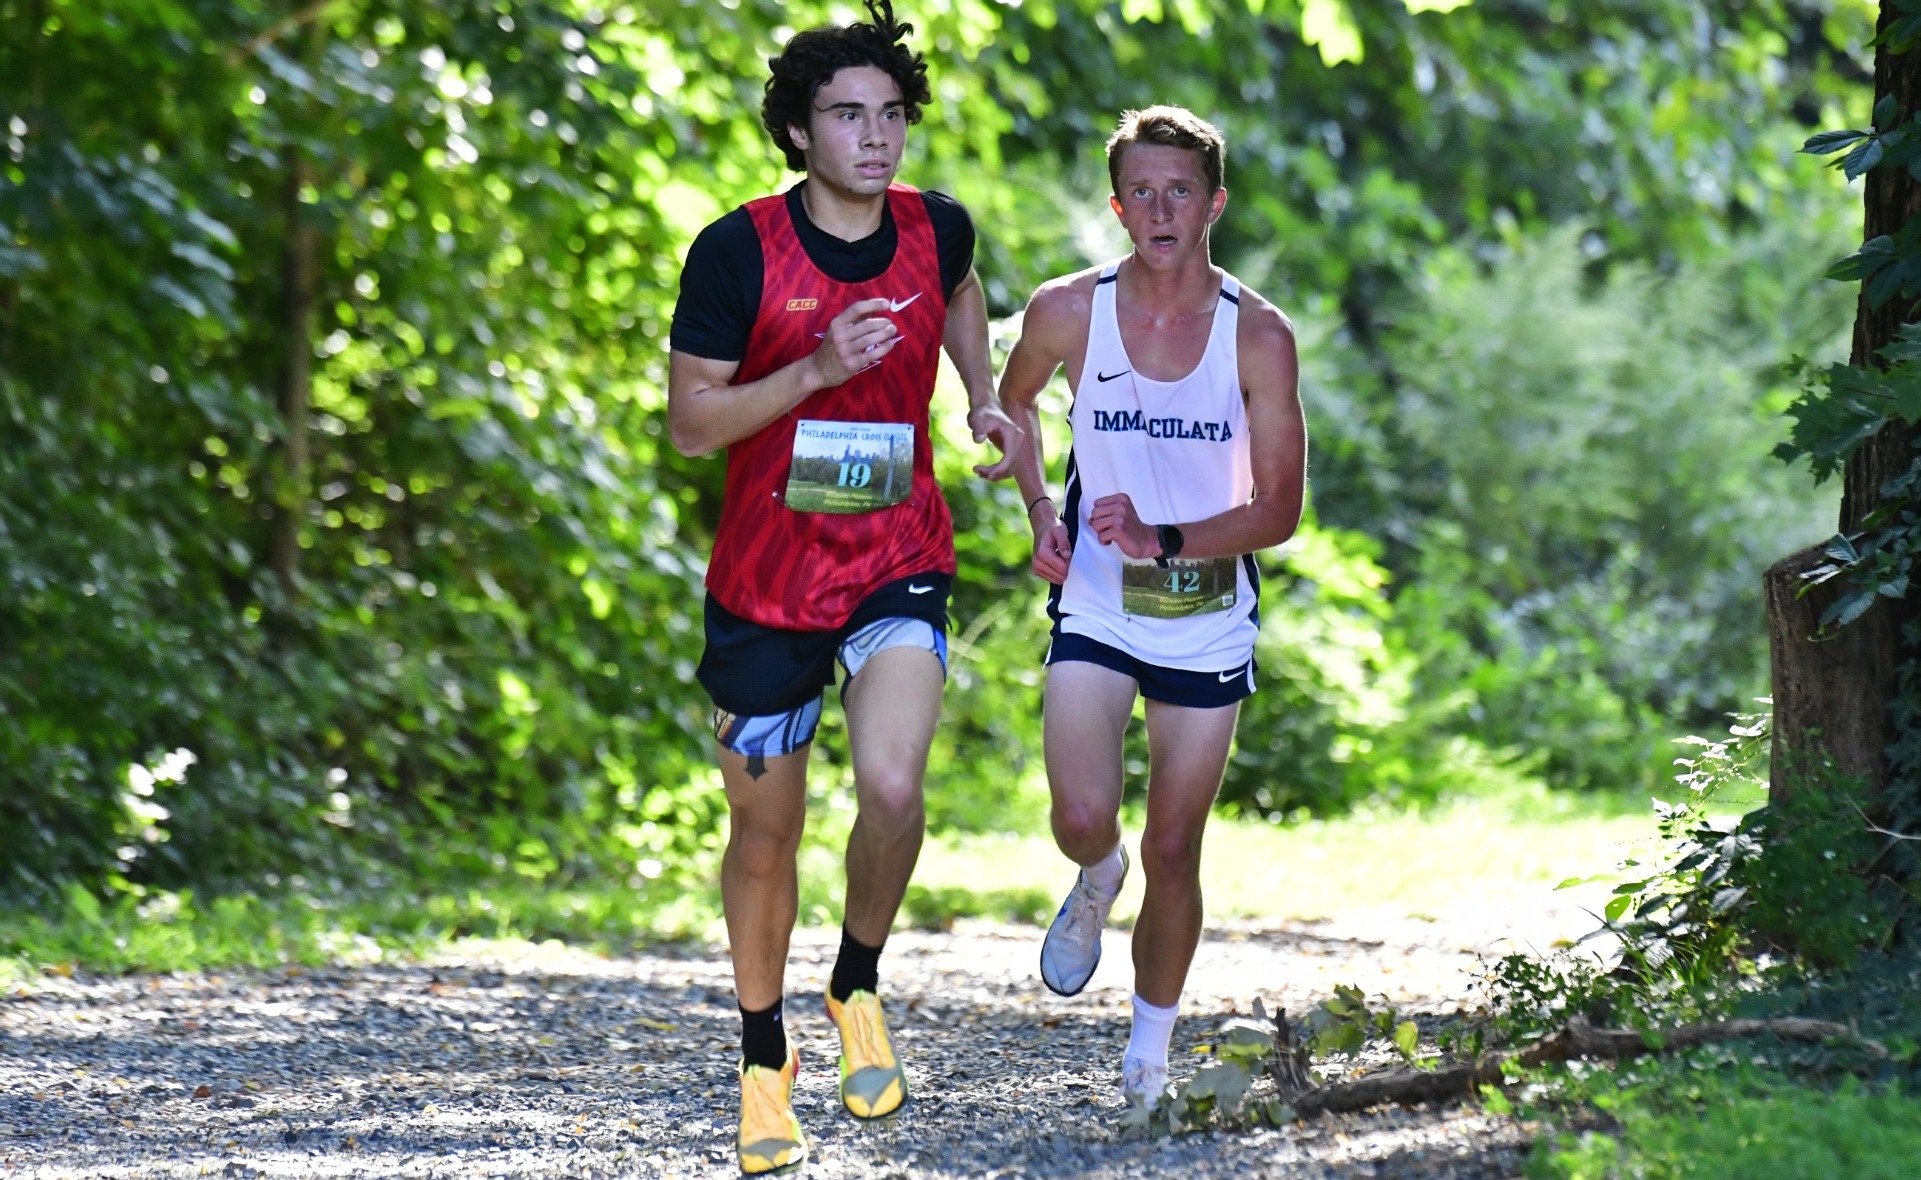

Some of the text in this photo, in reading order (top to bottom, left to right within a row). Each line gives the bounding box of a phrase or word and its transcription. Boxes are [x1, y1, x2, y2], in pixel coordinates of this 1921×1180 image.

[788, 300, 816, 310] CACC
[801, 429, 907, 443] PHILADELPHIA CROSS CLSSIC
[837, 463, 871, 488] 19
[1164, 572, 1200, 593] 42
